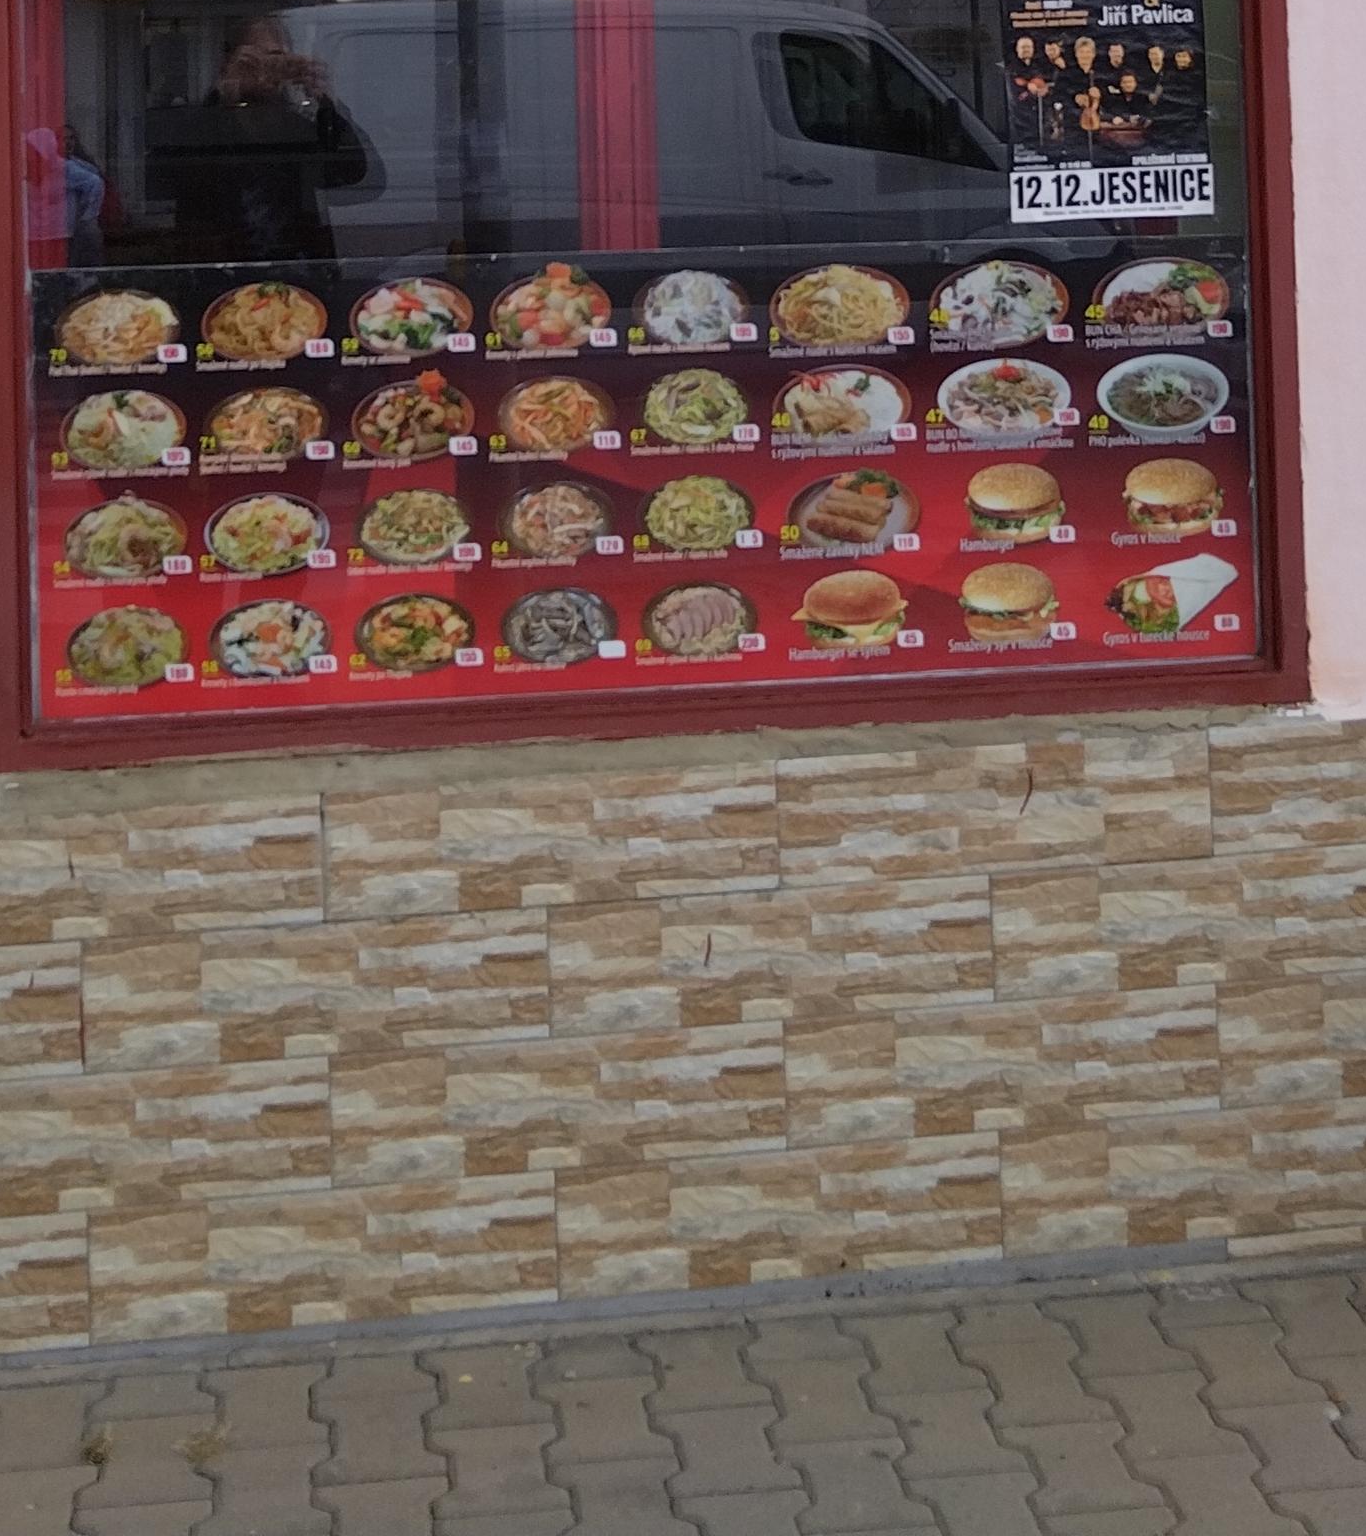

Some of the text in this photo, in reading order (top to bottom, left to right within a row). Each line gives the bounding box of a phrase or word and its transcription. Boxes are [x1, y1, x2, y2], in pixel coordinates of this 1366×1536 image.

[1098, 4, 1127, 26] Jiří
[1131, 3, 1194, 25] Pavlica
[926, 409, 945, 424] 47
[1088, 414, 1109, 429] 49
[780, 524, 801, 541] 50
[1110, 531, 1139, 548] Gyros
[960, 538, 1015, 554] Hamburger
[1102, 631, 1130, 648] Gyros
[789, 647, 845, 662] Hamburger
[847, 648, 858, 658] se
